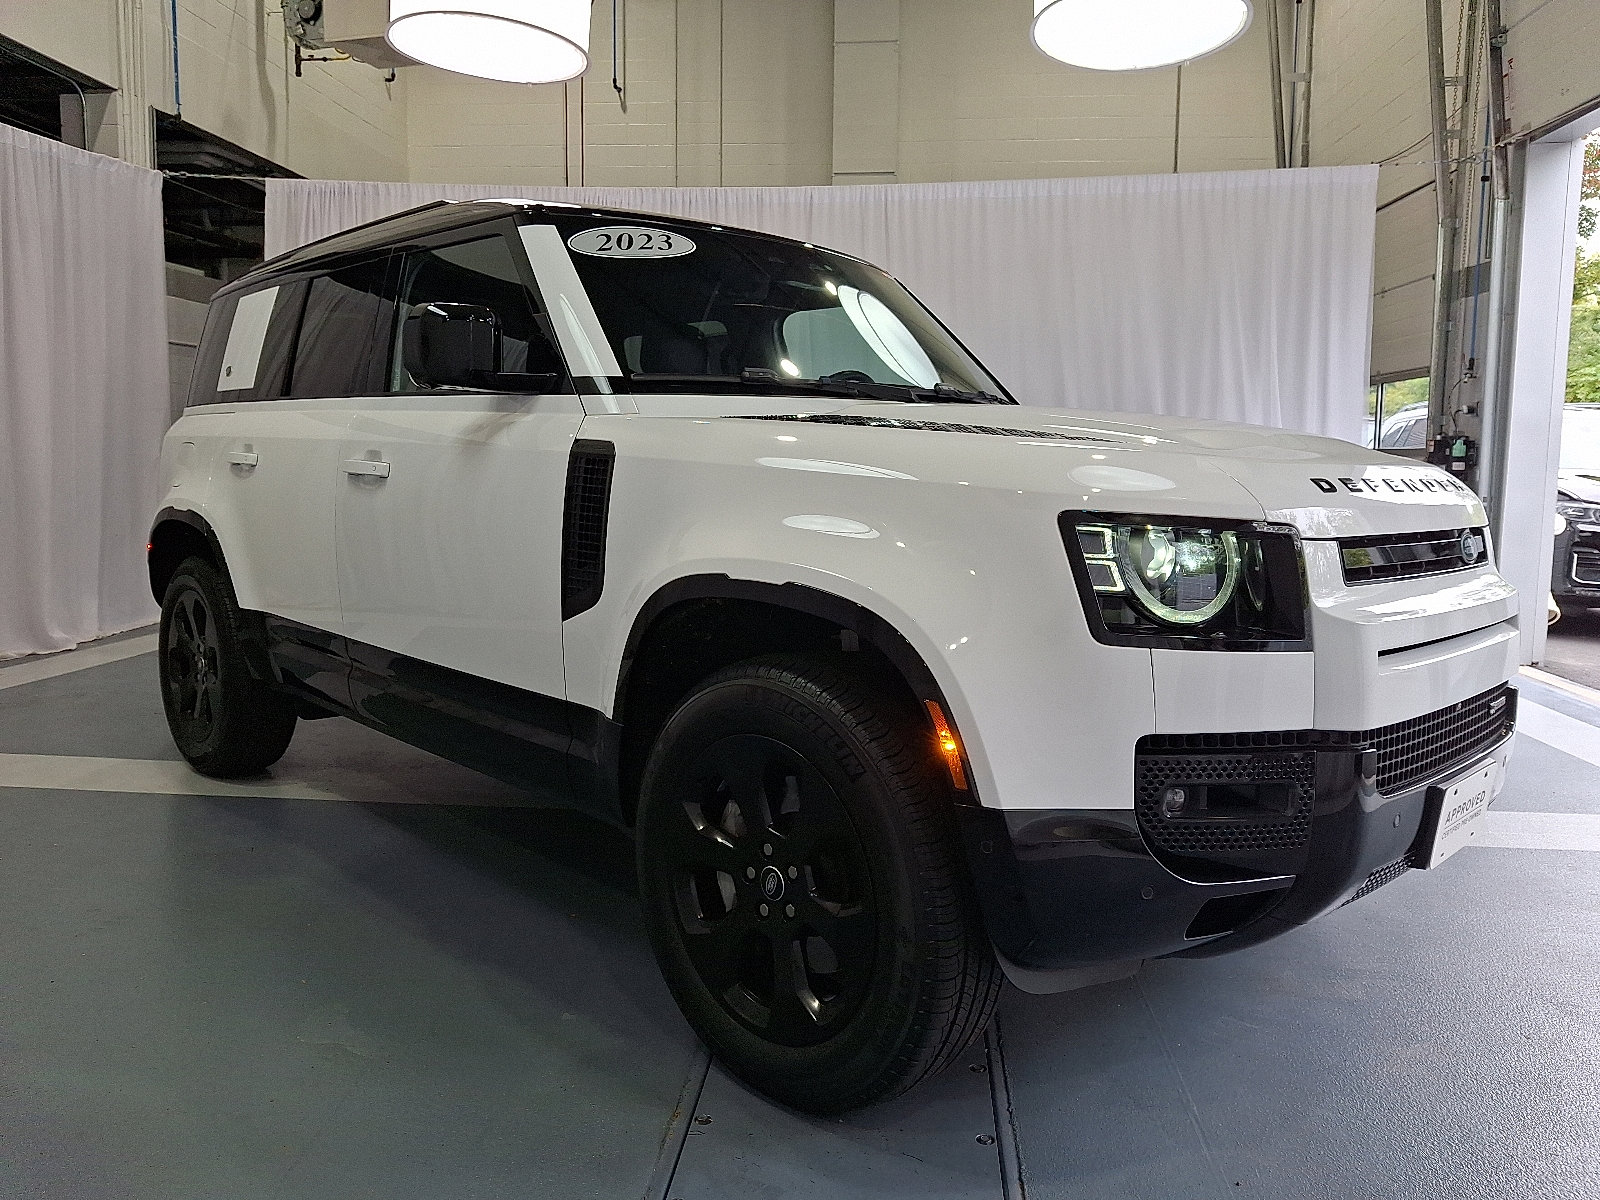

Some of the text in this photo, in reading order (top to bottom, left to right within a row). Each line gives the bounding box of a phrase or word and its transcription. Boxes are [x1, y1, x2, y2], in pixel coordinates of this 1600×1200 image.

[595, 232, 674, 252] 2023
[1309, 477, 1465, 493] DEFENDER
[1444, 790, 1486, 826] APPROVED
